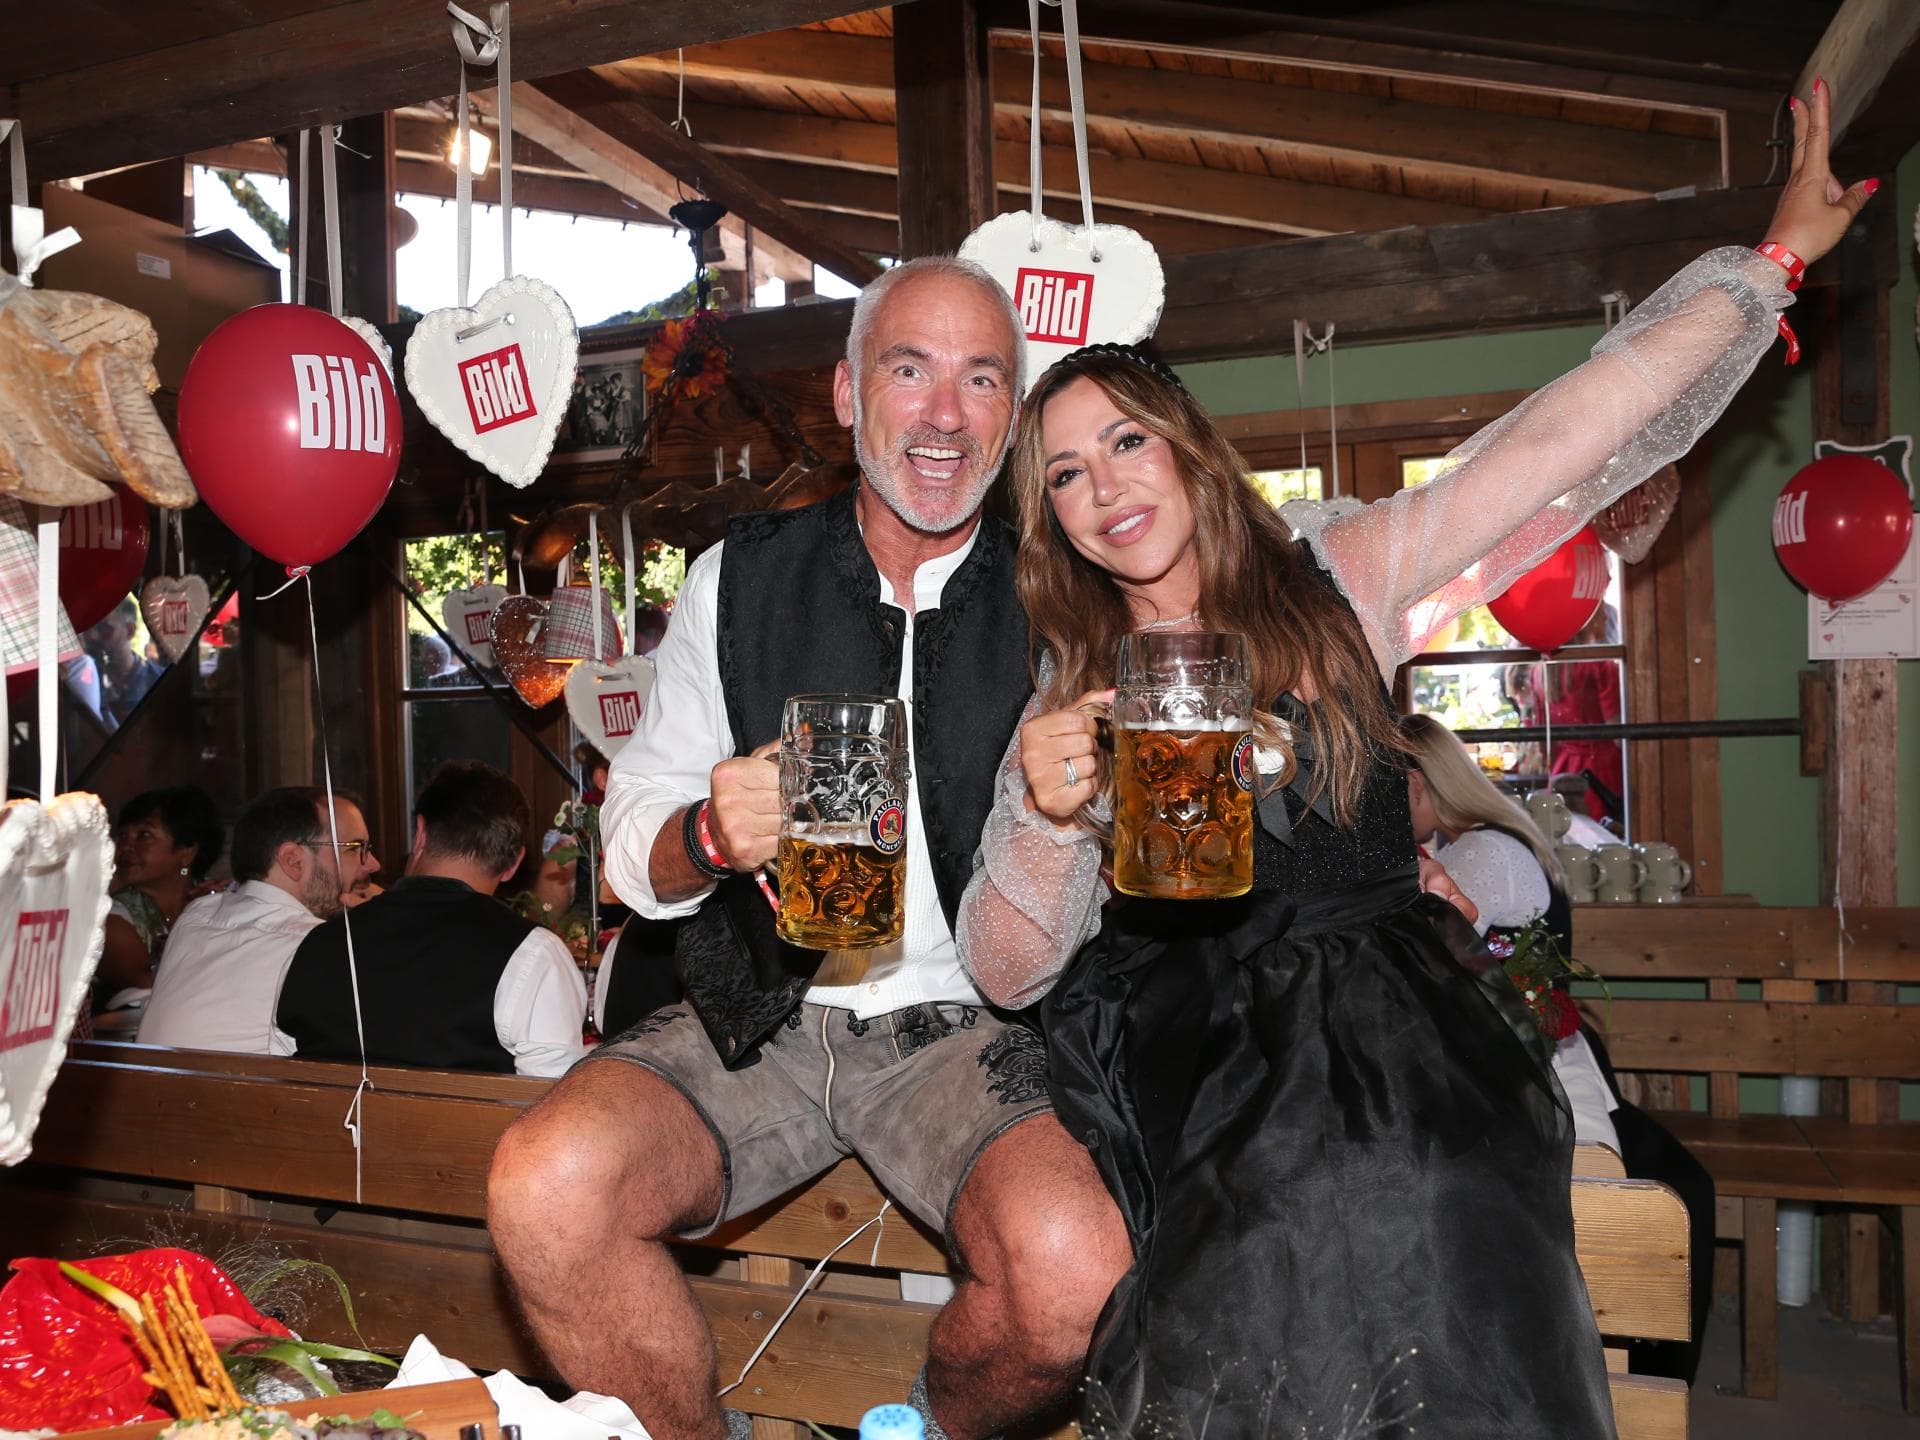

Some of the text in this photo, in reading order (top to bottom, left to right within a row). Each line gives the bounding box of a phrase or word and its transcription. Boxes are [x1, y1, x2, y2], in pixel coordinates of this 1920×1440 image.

[1019, 274, 1086, 338] Bild
[291, 354, 386, 454] Bild
[465, 351, 530, 426] Bild
[602, 695, 640, 733] Bild
[5, 922, 63, 1037] Bild
